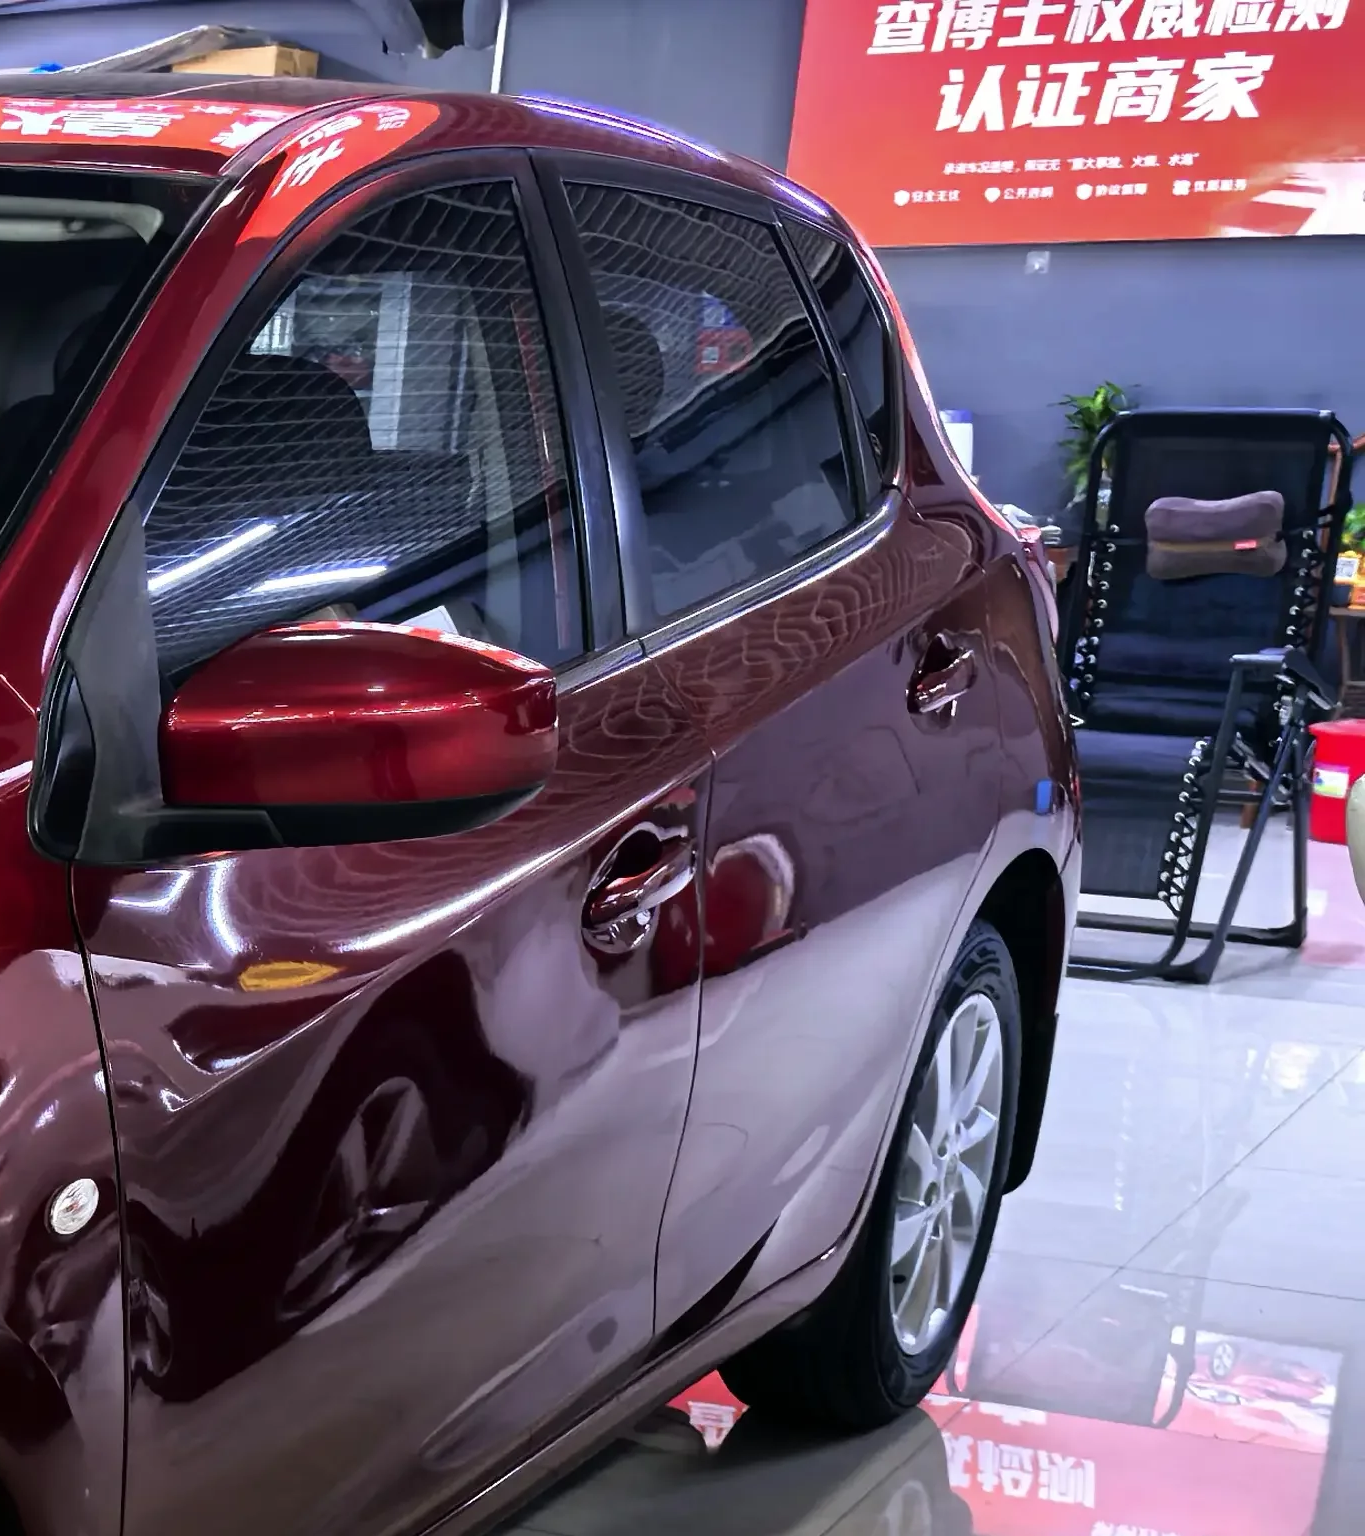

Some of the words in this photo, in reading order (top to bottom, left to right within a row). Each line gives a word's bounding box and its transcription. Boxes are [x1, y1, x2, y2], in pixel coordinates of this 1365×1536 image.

[867, 0, 1350, 54] 查博士权威检测
[935, 51, 1275, 132] 认证商家
